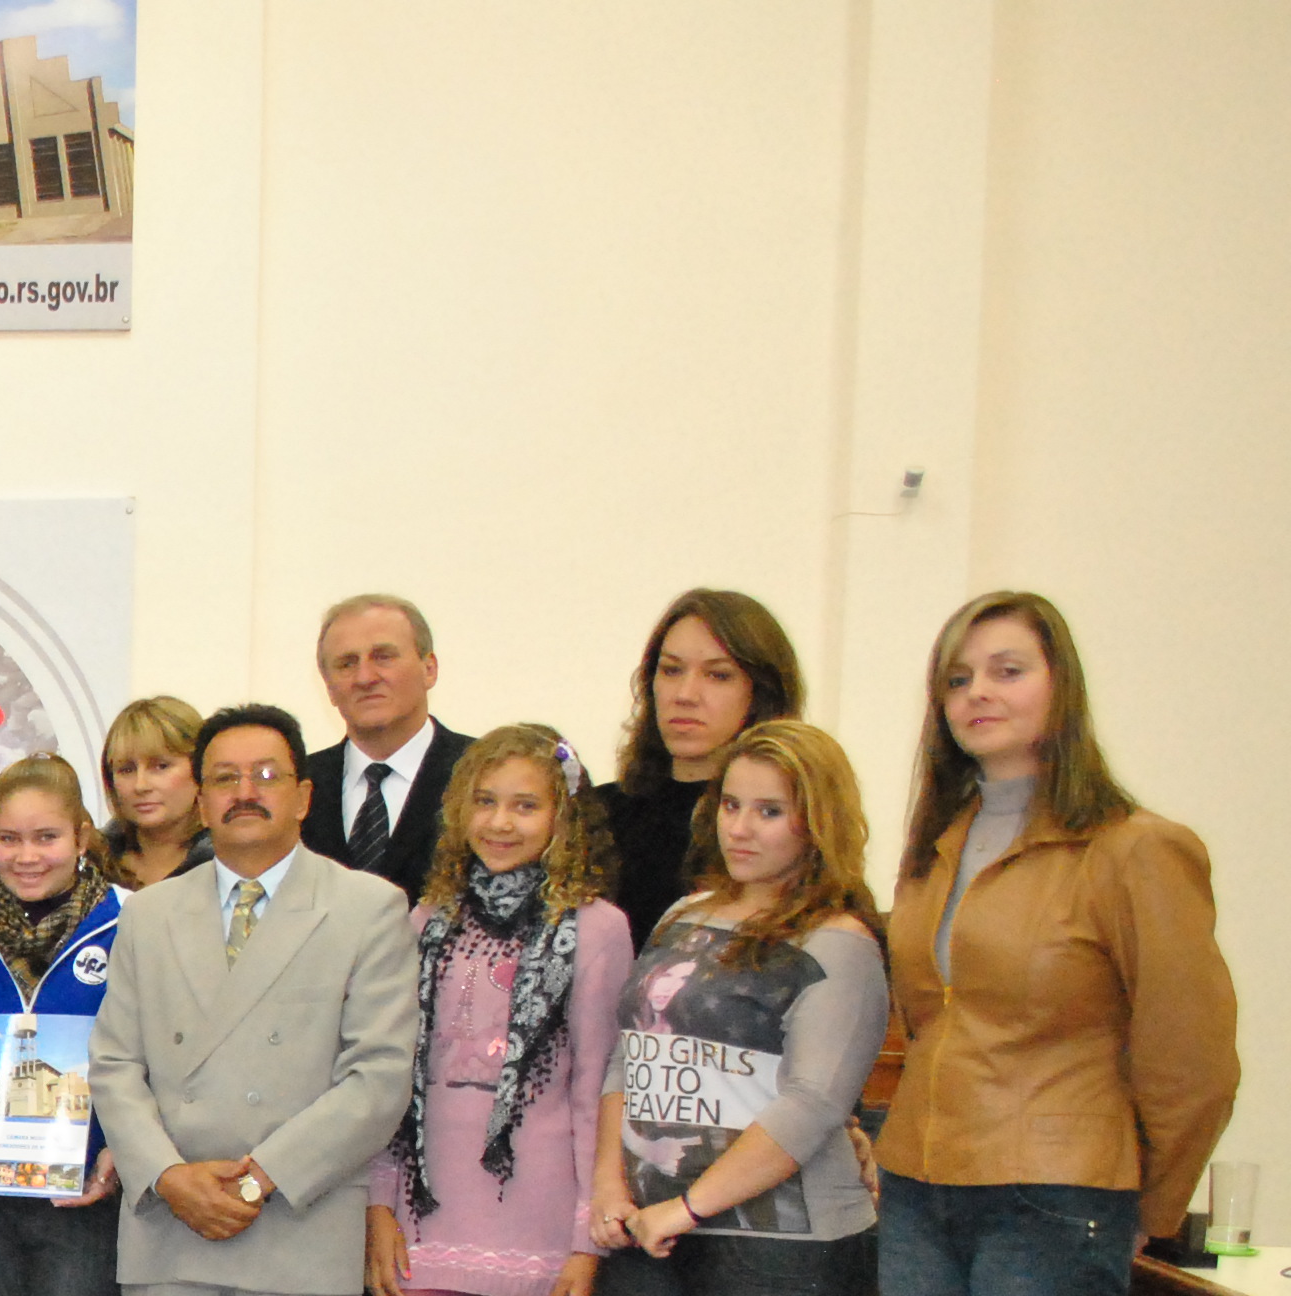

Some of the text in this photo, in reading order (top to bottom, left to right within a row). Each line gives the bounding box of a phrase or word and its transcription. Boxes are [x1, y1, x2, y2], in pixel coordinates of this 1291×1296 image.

[620, 1032, 756, 1077] OD GIRLS
[625, 1062, 701, 1095] GO TO
